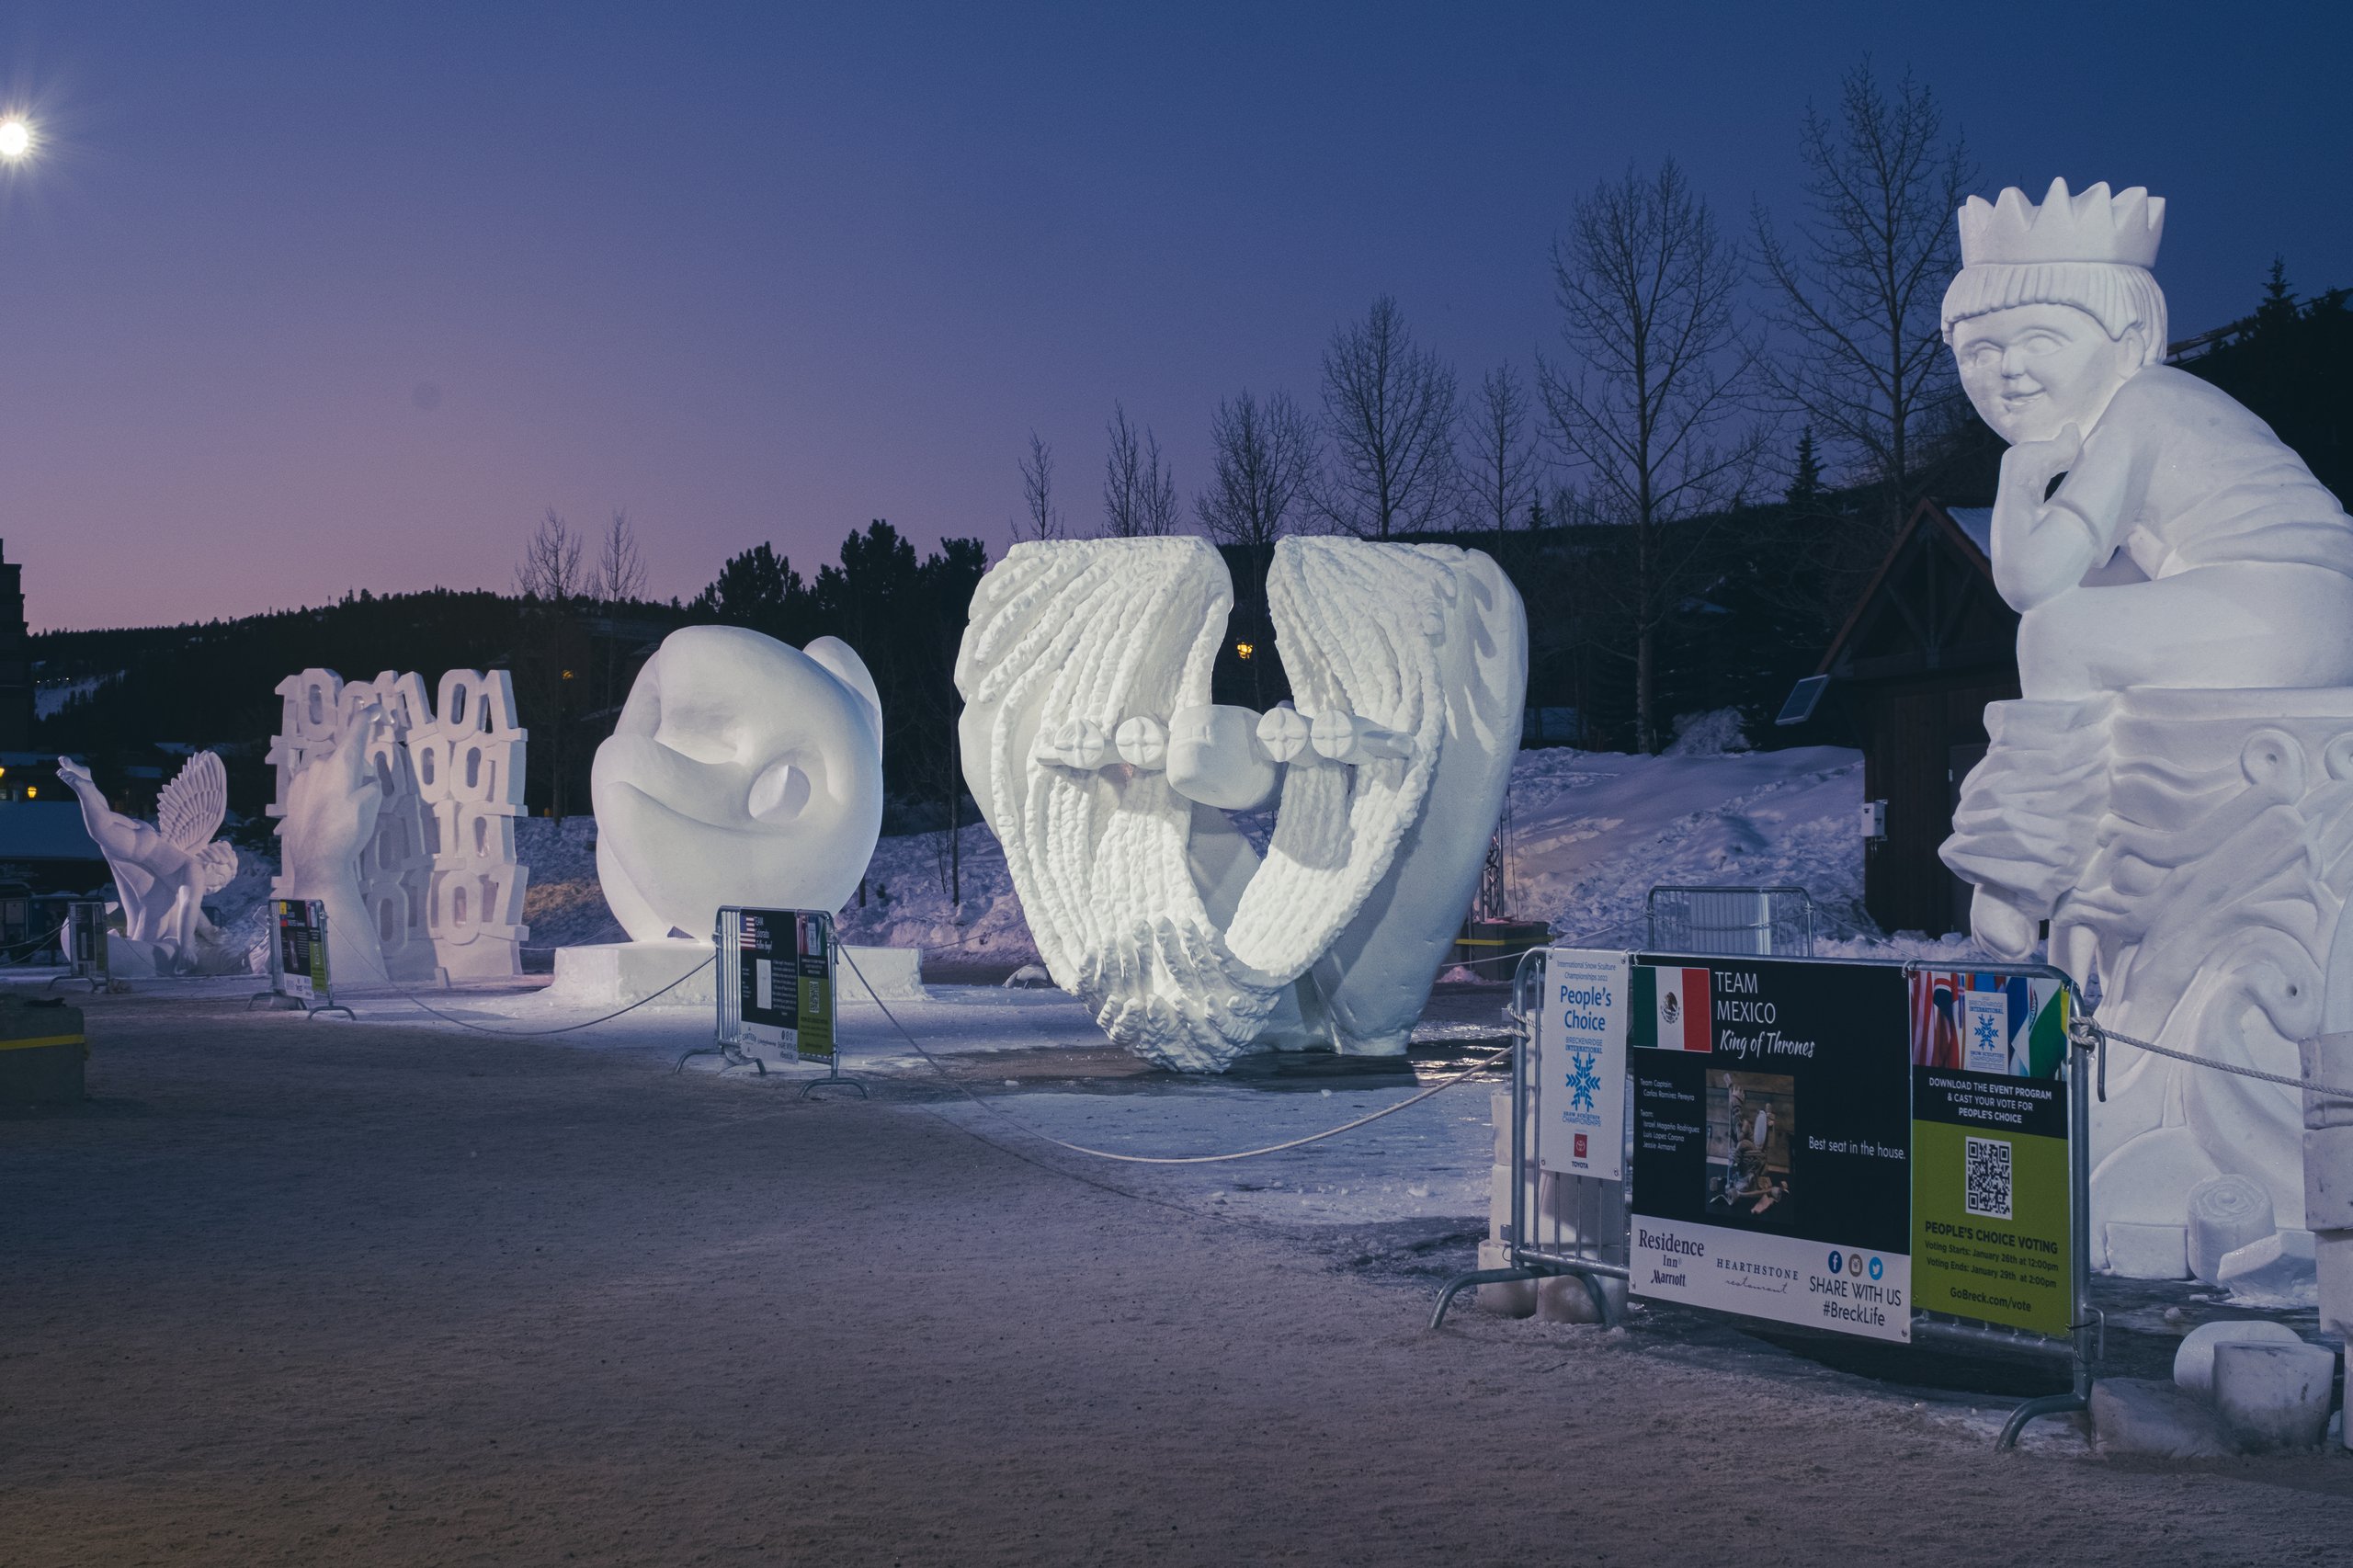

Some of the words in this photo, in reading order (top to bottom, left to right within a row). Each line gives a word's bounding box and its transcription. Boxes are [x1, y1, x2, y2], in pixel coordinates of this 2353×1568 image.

[1564, 971, 1597, 982] Championships
[1586, 961, 1597, 970] Snow
[1715, 971, 1758, 994] TEAM
[1560, 985, 1611, 1010] People's
[1564, 1009, 1606, 1031] Choice
[1717, 1000, 1776, 1024] MEXICO
[1565, 1036, 1603, 1047] BRECKENRIDGE
[1565, 1044, 1603, 1054] INTERNATIONAL
[1720, 1029, 1747, 1060] King
[1750, 1031, 1765, 1058] of
[1767, 1030, 1815, 1058] Thrones
[1640, 1078, 1653, 1086] Team
[1643, 1089, 1658, 1097] Carlos
[1929, 1077, 1972, 1091] DOWNLOAD
[1973, 1082, 1987, 1092] THE
[1989, 1084, 2013, 1096] EVENT
[2015, 1086, 2052, 1100] PROGRAM
[1947, 1092, 1952, 1102] &
[1953, 1093, 1972, 1104] CAST
[1974, 1096, 1995, 1107] YOUR
[1996, 1098, 2016, 1109] VOTE
[2018, 1101, 2033, 1111] FOR
[1562, 1116, 1602, 1127] CHAMPIONSHIPS
[1640, 1108, 1654, 1118] Team:
[1959, 1107, 1993, 1120] PEOPLE'S
[1995, 1111, 2022, 1124] CHOICE
[1808, 1135, 1826, 1150] Best
[1828, 1140, 1847, 1153] seat
[1849, 1141, 1859, 1154] in
[1860, 1140, 1874, 1156] the
[1877, 1142, 1906, 1160] house.
[1572, 1161, 1588, 1170] TOYOTA
[1639, 1229, 1705, 1256] Residence
[1925, 1221, 1973, 1240] PEOPLE'S
[1976, 1229, 2016, 1246] CHOICE
[2018, 1236, 2059, 1255] VOTING
[1925, 1240, 1948, 1254] Voting
[1949, 1244, 1971, 1256] Starts:
[1972, 1248, 2000, 1263] January
[2001, 1253, 2018, 1265] 26th
[2019, 1256, 2027, 1266] at
[2028, 1257, 2059, 1272] 12:00pm
[1651, 1269, 1687, 1287] Marriott
[1716, 1258, 1799, 1280] HEARTHSTONE
[1927, 1256, 1949, 1270] Voting
[1950, 1260, 1970, 1272] Ends:
[1971, 1263, 1998, 1278] January
[2000, 1269, 2016, 1280] 29th
[2019, 1274, 2027, 1282] at
[2029, 1274, 2057, 1289] 2:00pm
[1725, 1276, 1788, 1294] restaurant
[1809, 1275, 1847, 1298] SHARE
[1851, 1282, 1883, 1304] WITH
[1886, 1289, 1902, 1307] US
[1949, 1287, 2031, 1312] GoBreck.com/vote
[1823, 1301, 1885, 1326] #BreckLife
